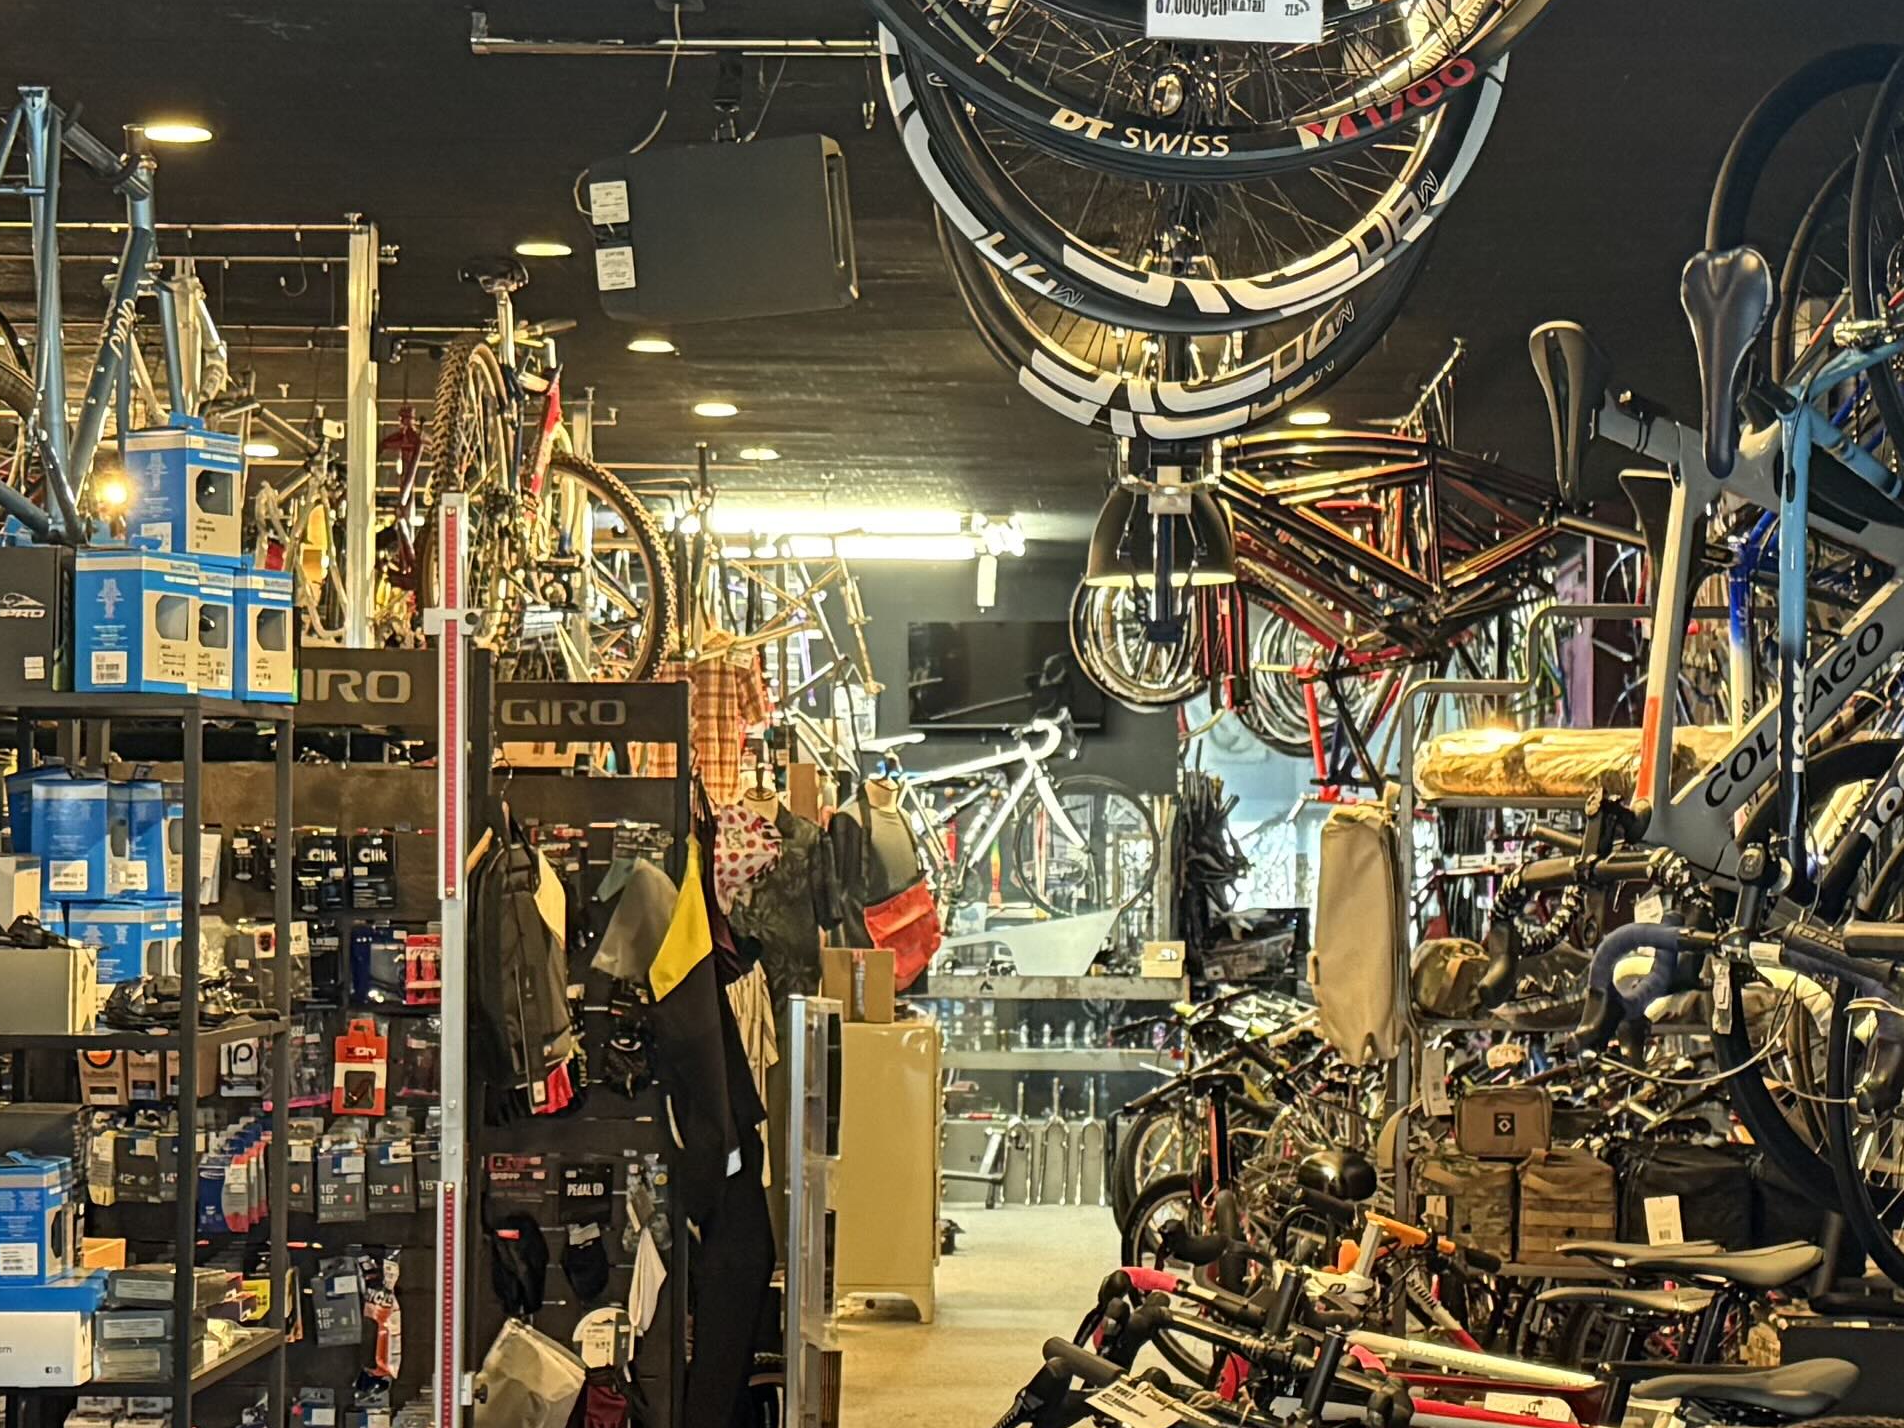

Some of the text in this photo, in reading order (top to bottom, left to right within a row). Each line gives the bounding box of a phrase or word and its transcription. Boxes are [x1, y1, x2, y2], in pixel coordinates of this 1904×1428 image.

[1049, 107, 1114, 141] DT
[301, 668, 412, 704] IRO
[500, 698, 627, 726] GIRO
[1704, 622, 1885, 810] COLAGO
[307, 847, 338, 863] Clik
[358, 847, 388, 863] Clik
